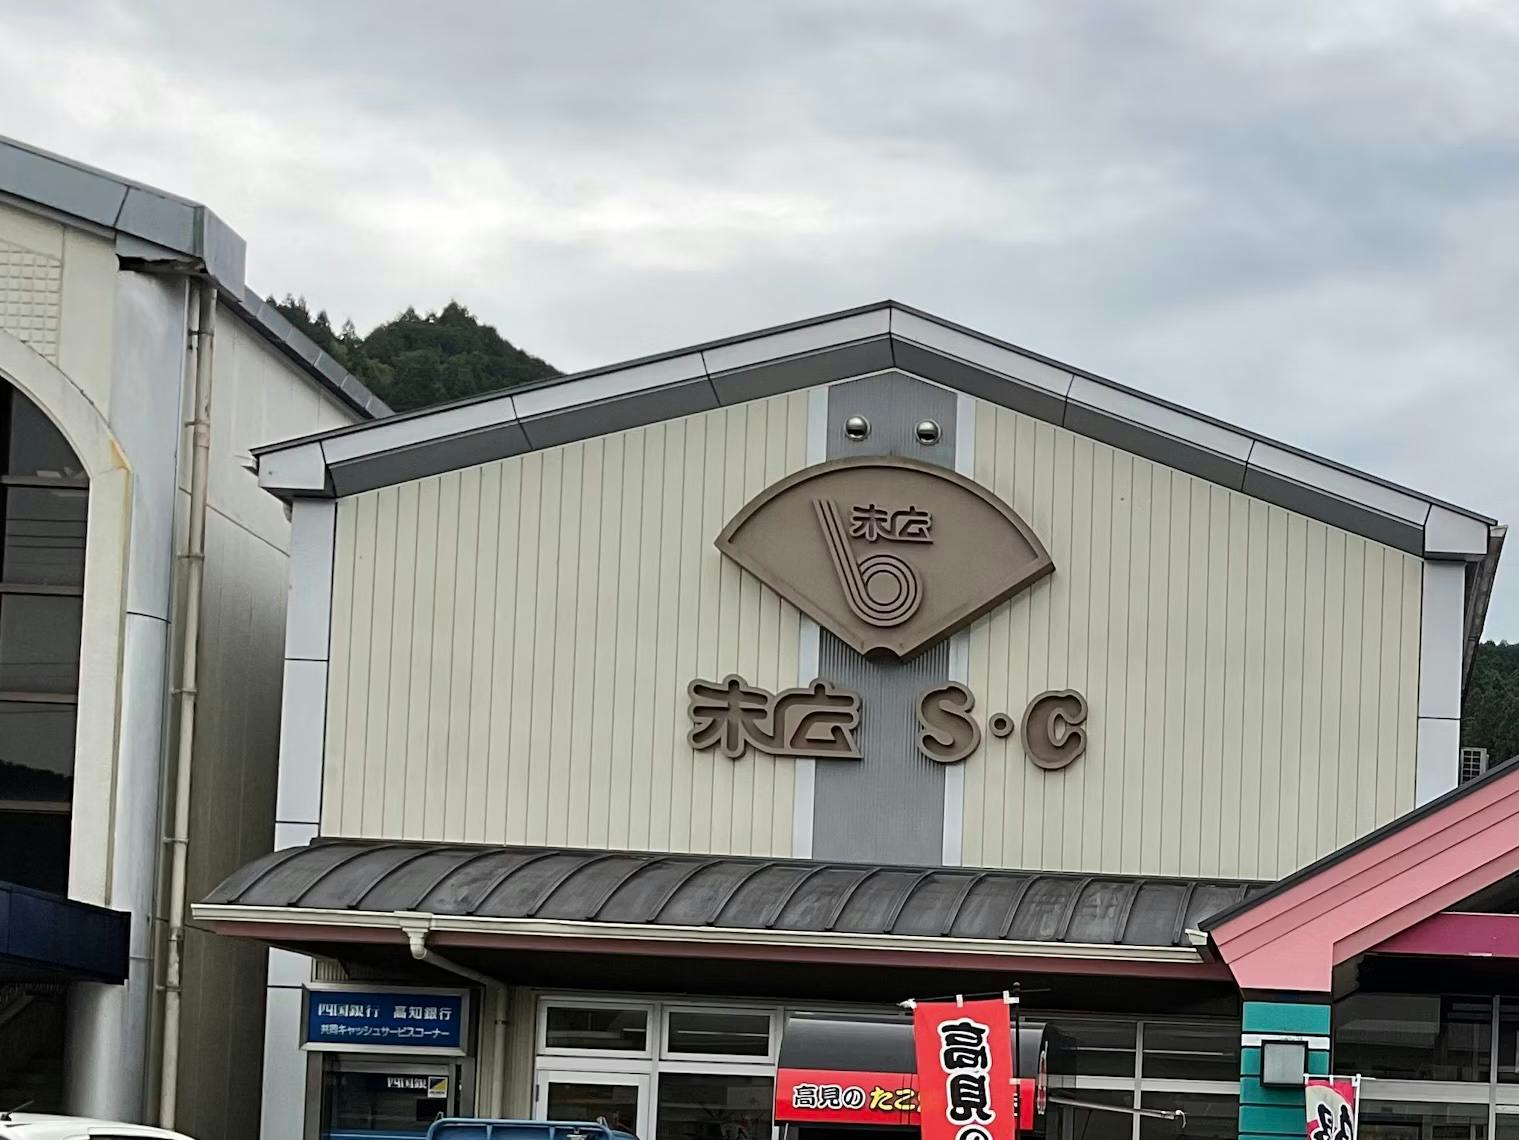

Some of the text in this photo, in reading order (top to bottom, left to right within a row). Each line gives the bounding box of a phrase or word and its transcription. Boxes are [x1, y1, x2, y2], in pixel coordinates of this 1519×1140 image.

[318, 1003, 452, 1021] 四国銀行 高知銀行
[387, 1077, 428, 1089] 四国銀
[793, 1083, 921, 1111] 高見のたこ
